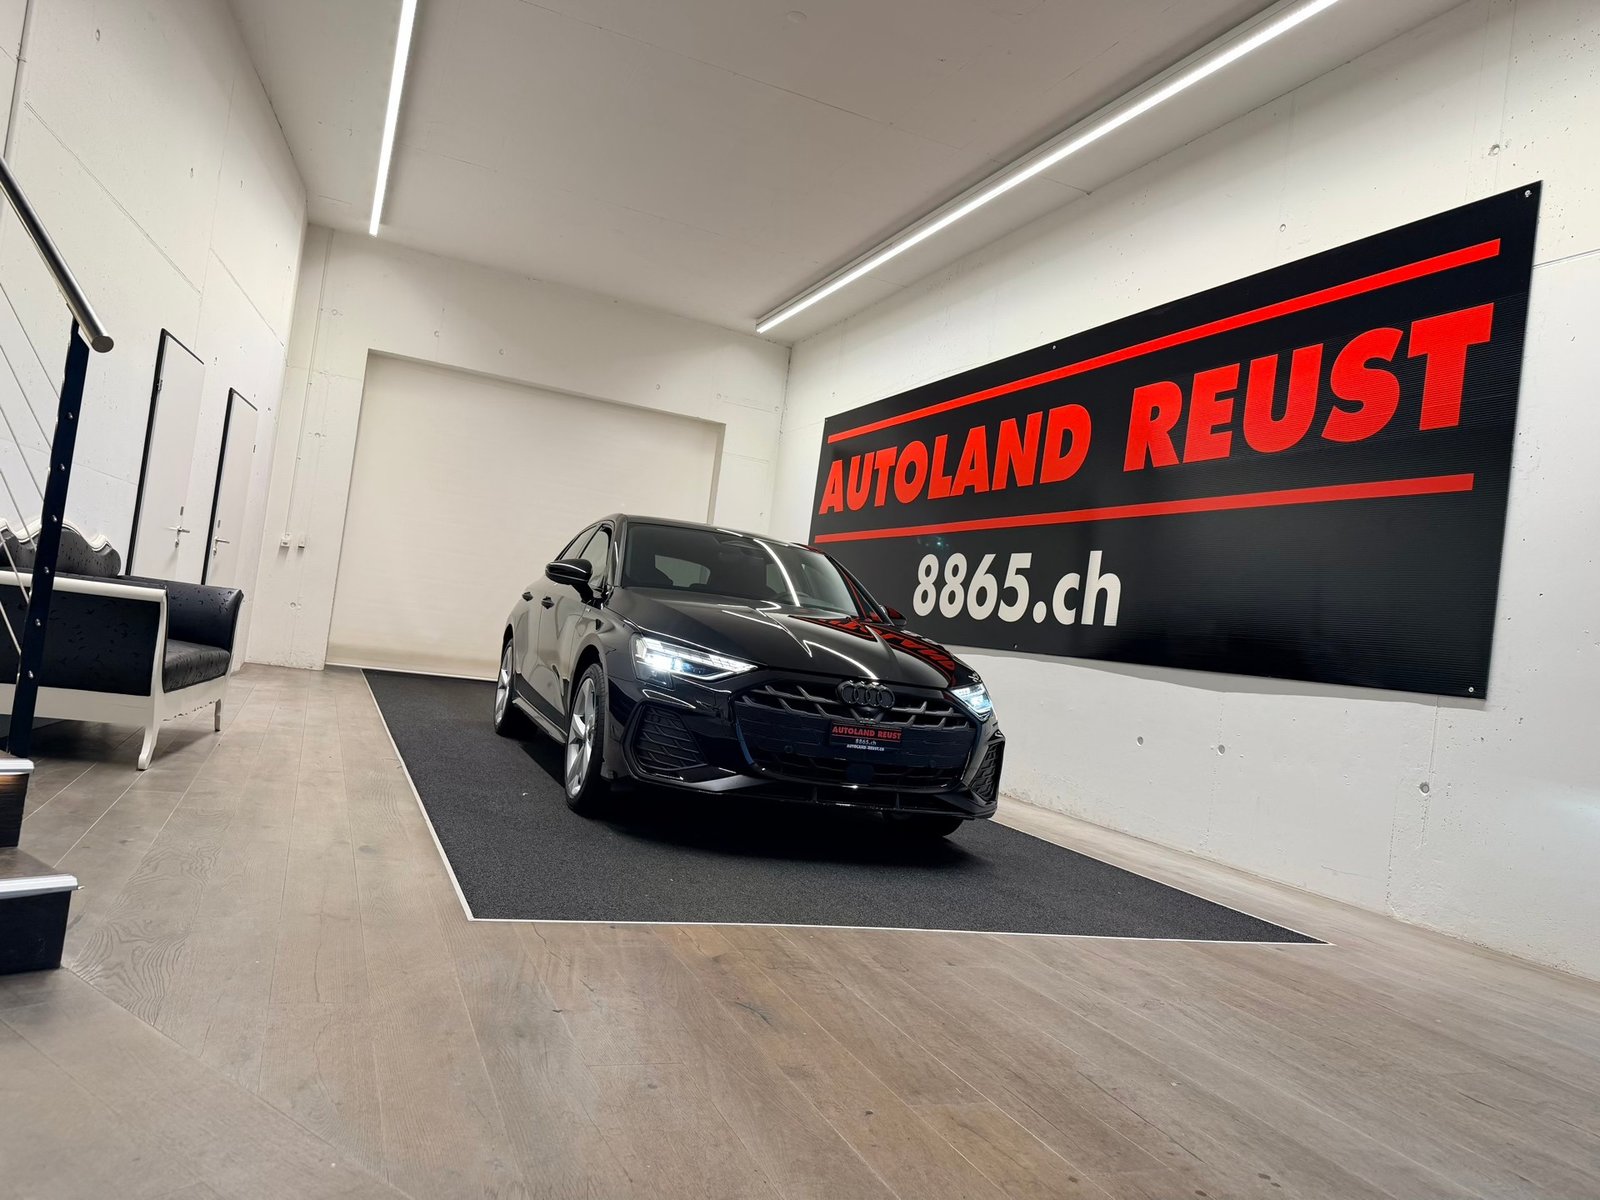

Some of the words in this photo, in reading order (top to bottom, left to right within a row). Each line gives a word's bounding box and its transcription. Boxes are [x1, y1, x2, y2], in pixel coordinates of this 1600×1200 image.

[819, 403, 1092, 515] AUTOLAND
[1123, 302, 1495, 472] REUST
[912, 550, 1122, 627] 8865.ch
[832, 726, 875, 737] AUTOLAND
[877, 730, 902, 740] REUST
